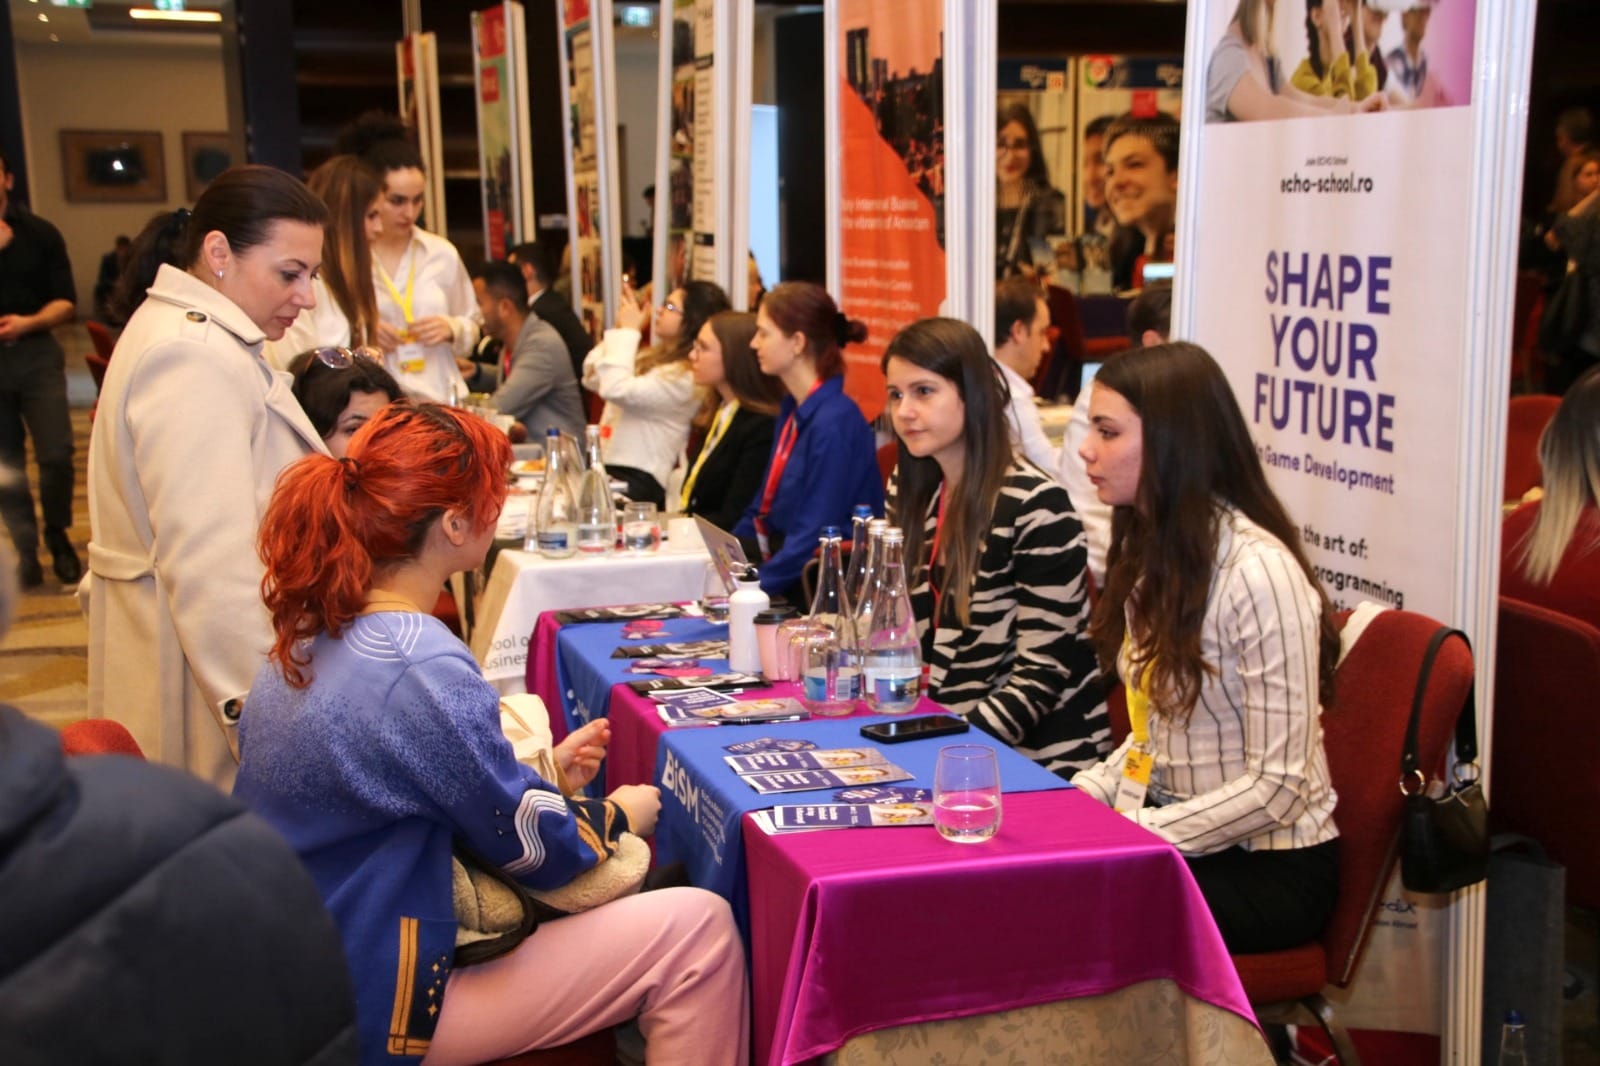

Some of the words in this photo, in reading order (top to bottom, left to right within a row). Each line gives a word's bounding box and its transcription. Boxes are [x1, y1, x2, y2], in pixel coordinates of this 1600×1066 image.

[1280, 171, 1374, 193] echo-school.ro
[1265, 250, 1392, 315] SHAPE
[1271, 313, 1378, 382] YOUR
[1254, 372, 1395, 453] FUTURE
[1264, 445, 1300, 471] Game
[1304, 453, 1394, 495] Development
[1304, 524, 1320, 547] the
[1323, 535, 1345, 554] art
[1349, 537, 1368, 560] of:
